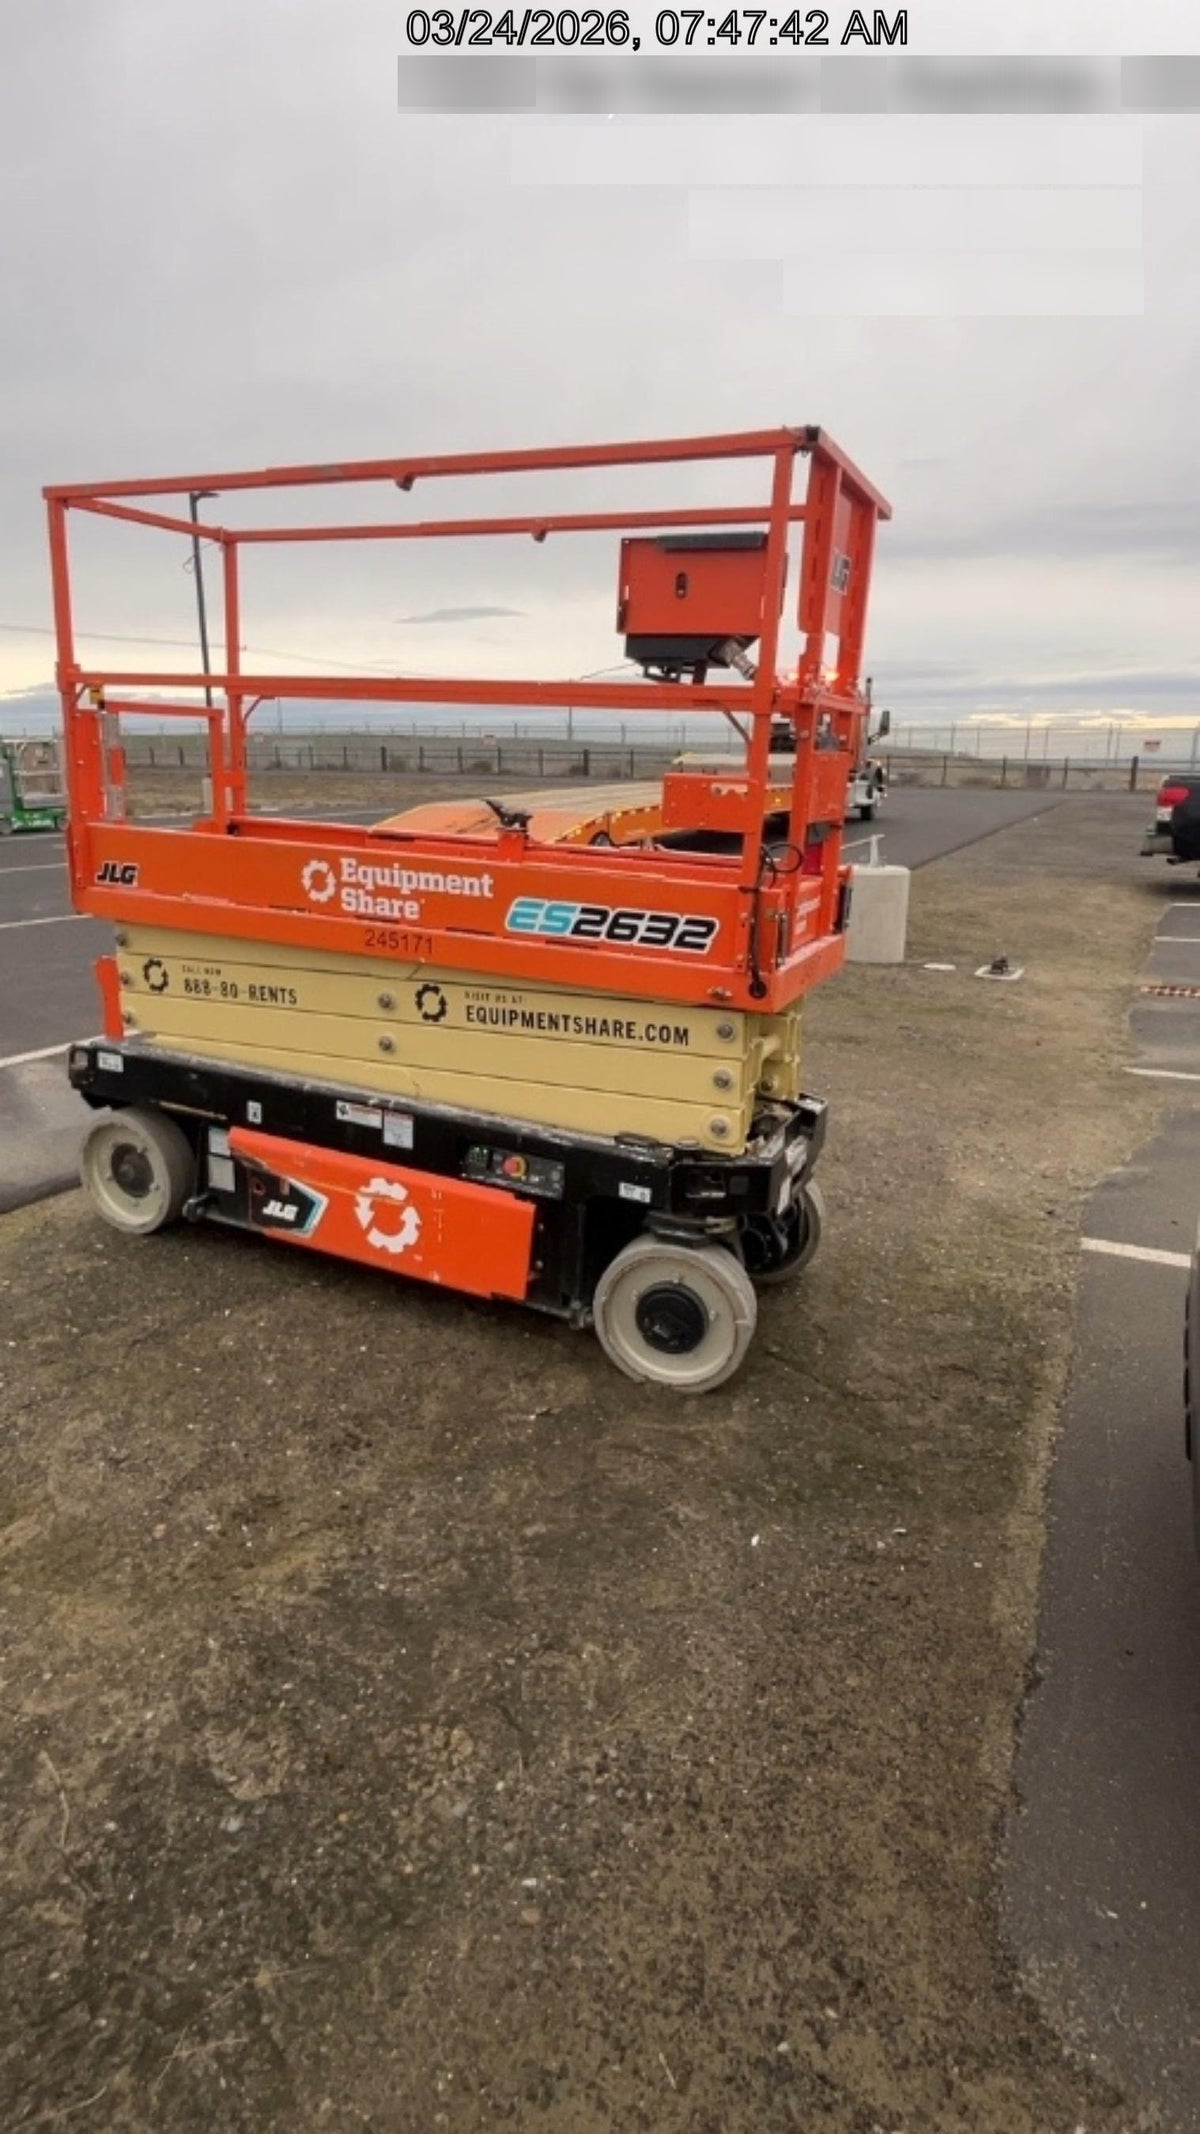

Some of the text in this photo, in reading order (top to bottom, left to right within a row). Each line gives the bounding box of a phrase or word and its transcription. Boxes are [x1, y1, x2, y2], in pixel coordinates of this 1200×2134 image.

[96, 861, 138, 887] JLG
[340, 857, 493, 897] Equipment
[341, 886, 420, 919] Share
[364, 928, 433, 954] 245171
[506, 897, 719, 953] ES2632
[466, 1004, 690, 1046] EQUIPMENTSHARE.COM
[262, 1199, 299, 1222] JLG
